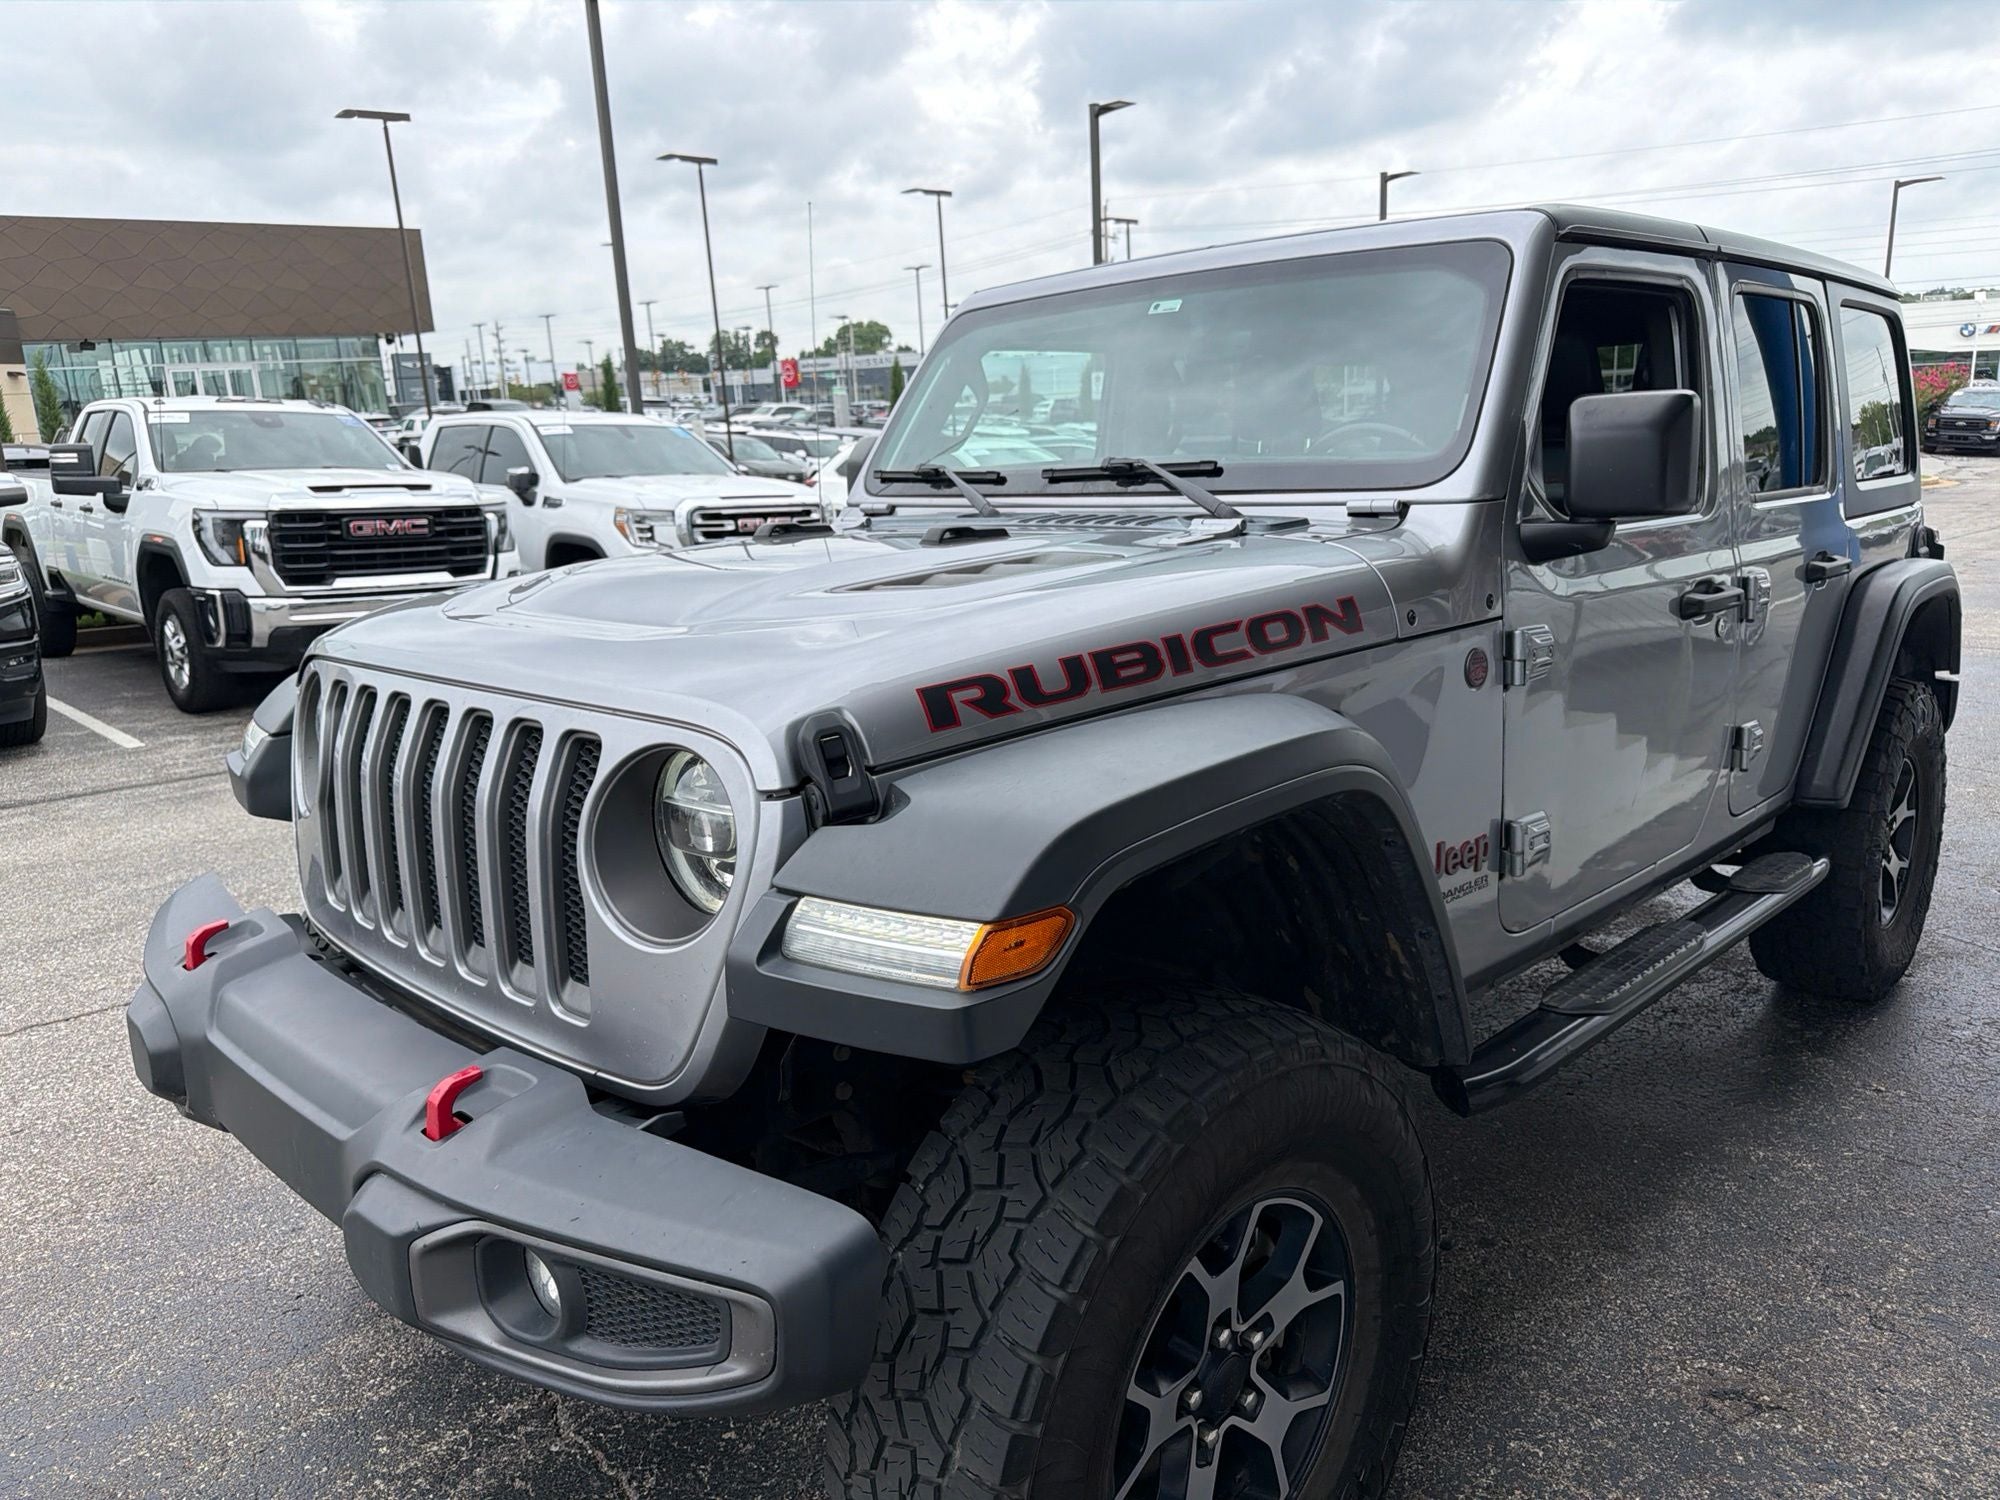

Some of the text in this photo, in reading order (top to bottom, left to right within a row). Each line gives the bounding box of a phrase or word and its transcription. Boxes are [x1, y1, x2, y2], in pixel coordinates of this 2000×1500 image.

[349, 518, 429, 537] GMC
[915, 595, 1364, 733] RUBICON
[1434, 833, 1489, 877] Jeep
[1441, 874, 1489, 899] ANGLER
